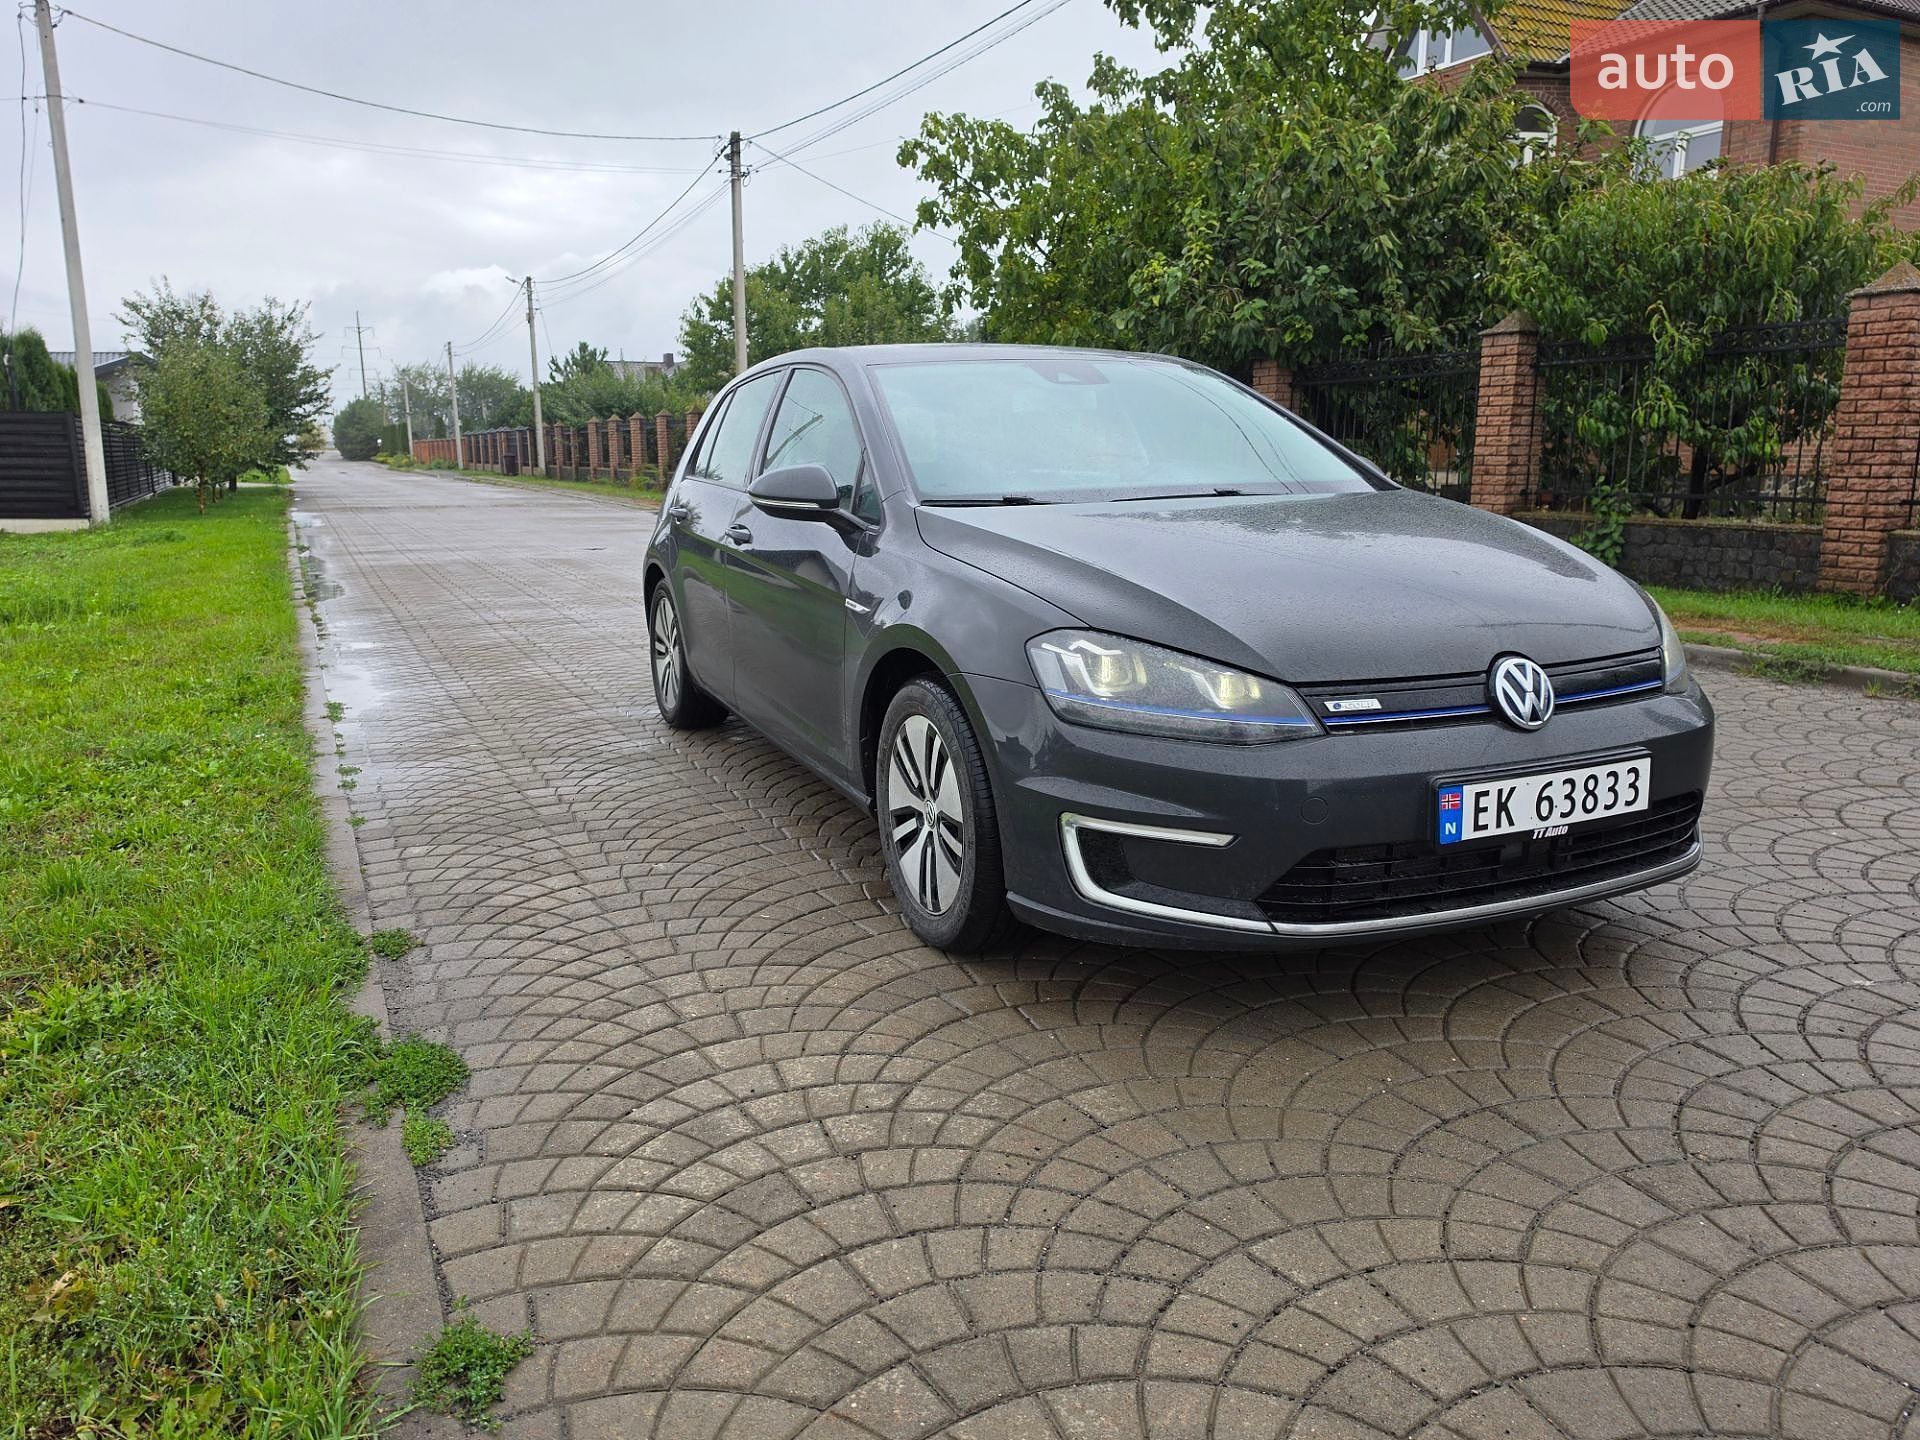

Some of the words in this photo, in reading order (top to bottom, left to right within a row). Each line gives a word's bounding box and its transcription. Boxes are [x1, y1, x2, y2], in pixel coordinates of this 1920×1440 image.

[1472, 785, 1518, 832] EK
[1535, 766, 1640, 822] 63833
[1445, 822, 1457, 835] N
[1532, 828, 1546, 839] TT
[1544, 825, 1569, 837] Auto
